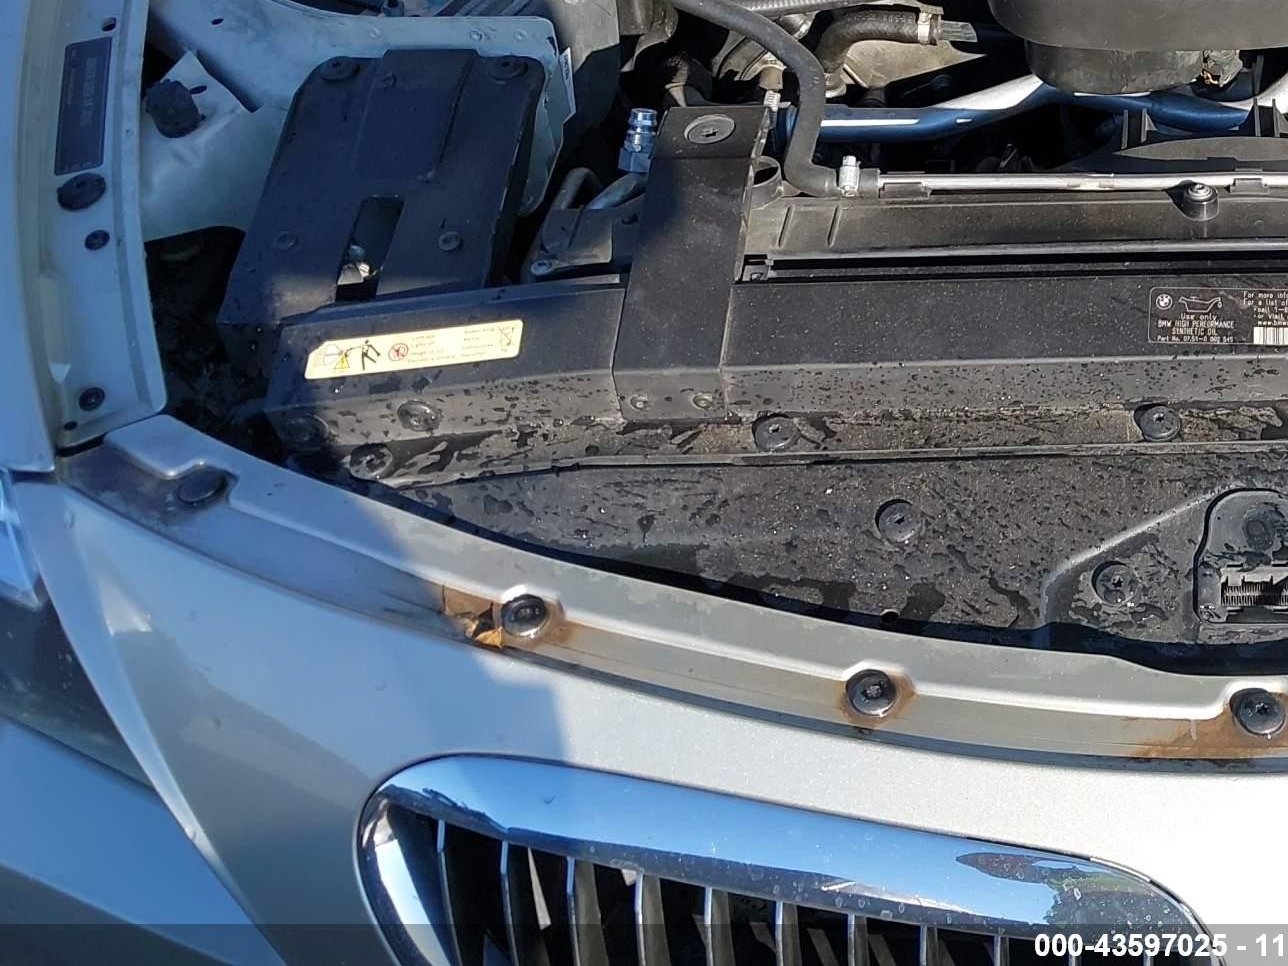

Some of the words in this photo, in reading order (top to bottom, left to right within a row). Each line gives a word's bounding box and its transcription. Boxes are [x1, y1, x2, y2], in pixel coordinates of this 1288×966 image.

[1200, 313, 1217, 321] only
[1172, 327, 1205, 335] SYNTHETIC
[1207, 327, 1218, 335] OIL
